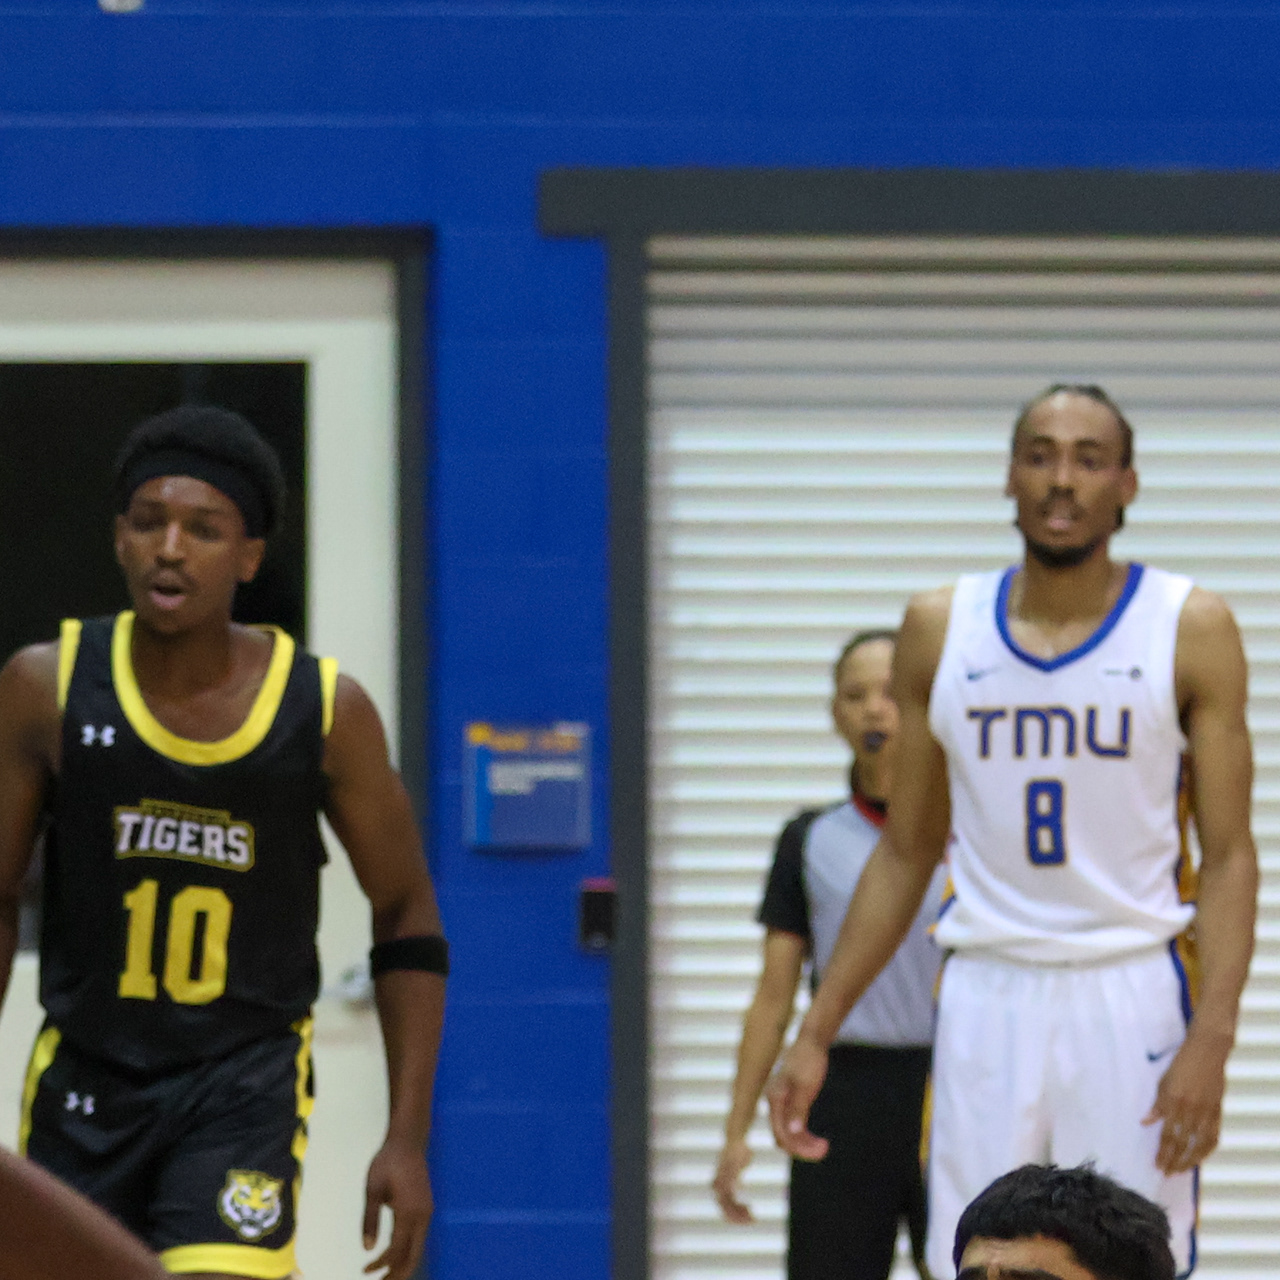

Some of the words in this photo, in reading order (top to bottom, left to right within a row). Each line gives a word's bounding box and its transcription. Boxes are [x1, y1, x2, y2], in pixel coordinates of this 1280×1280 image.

[967, 706, 1132, 758] TMU
[117, 812, 251, 866] TIGERS
[1025, 779, 1066, 868] 8
[118, 878, 233, 1005] 10
